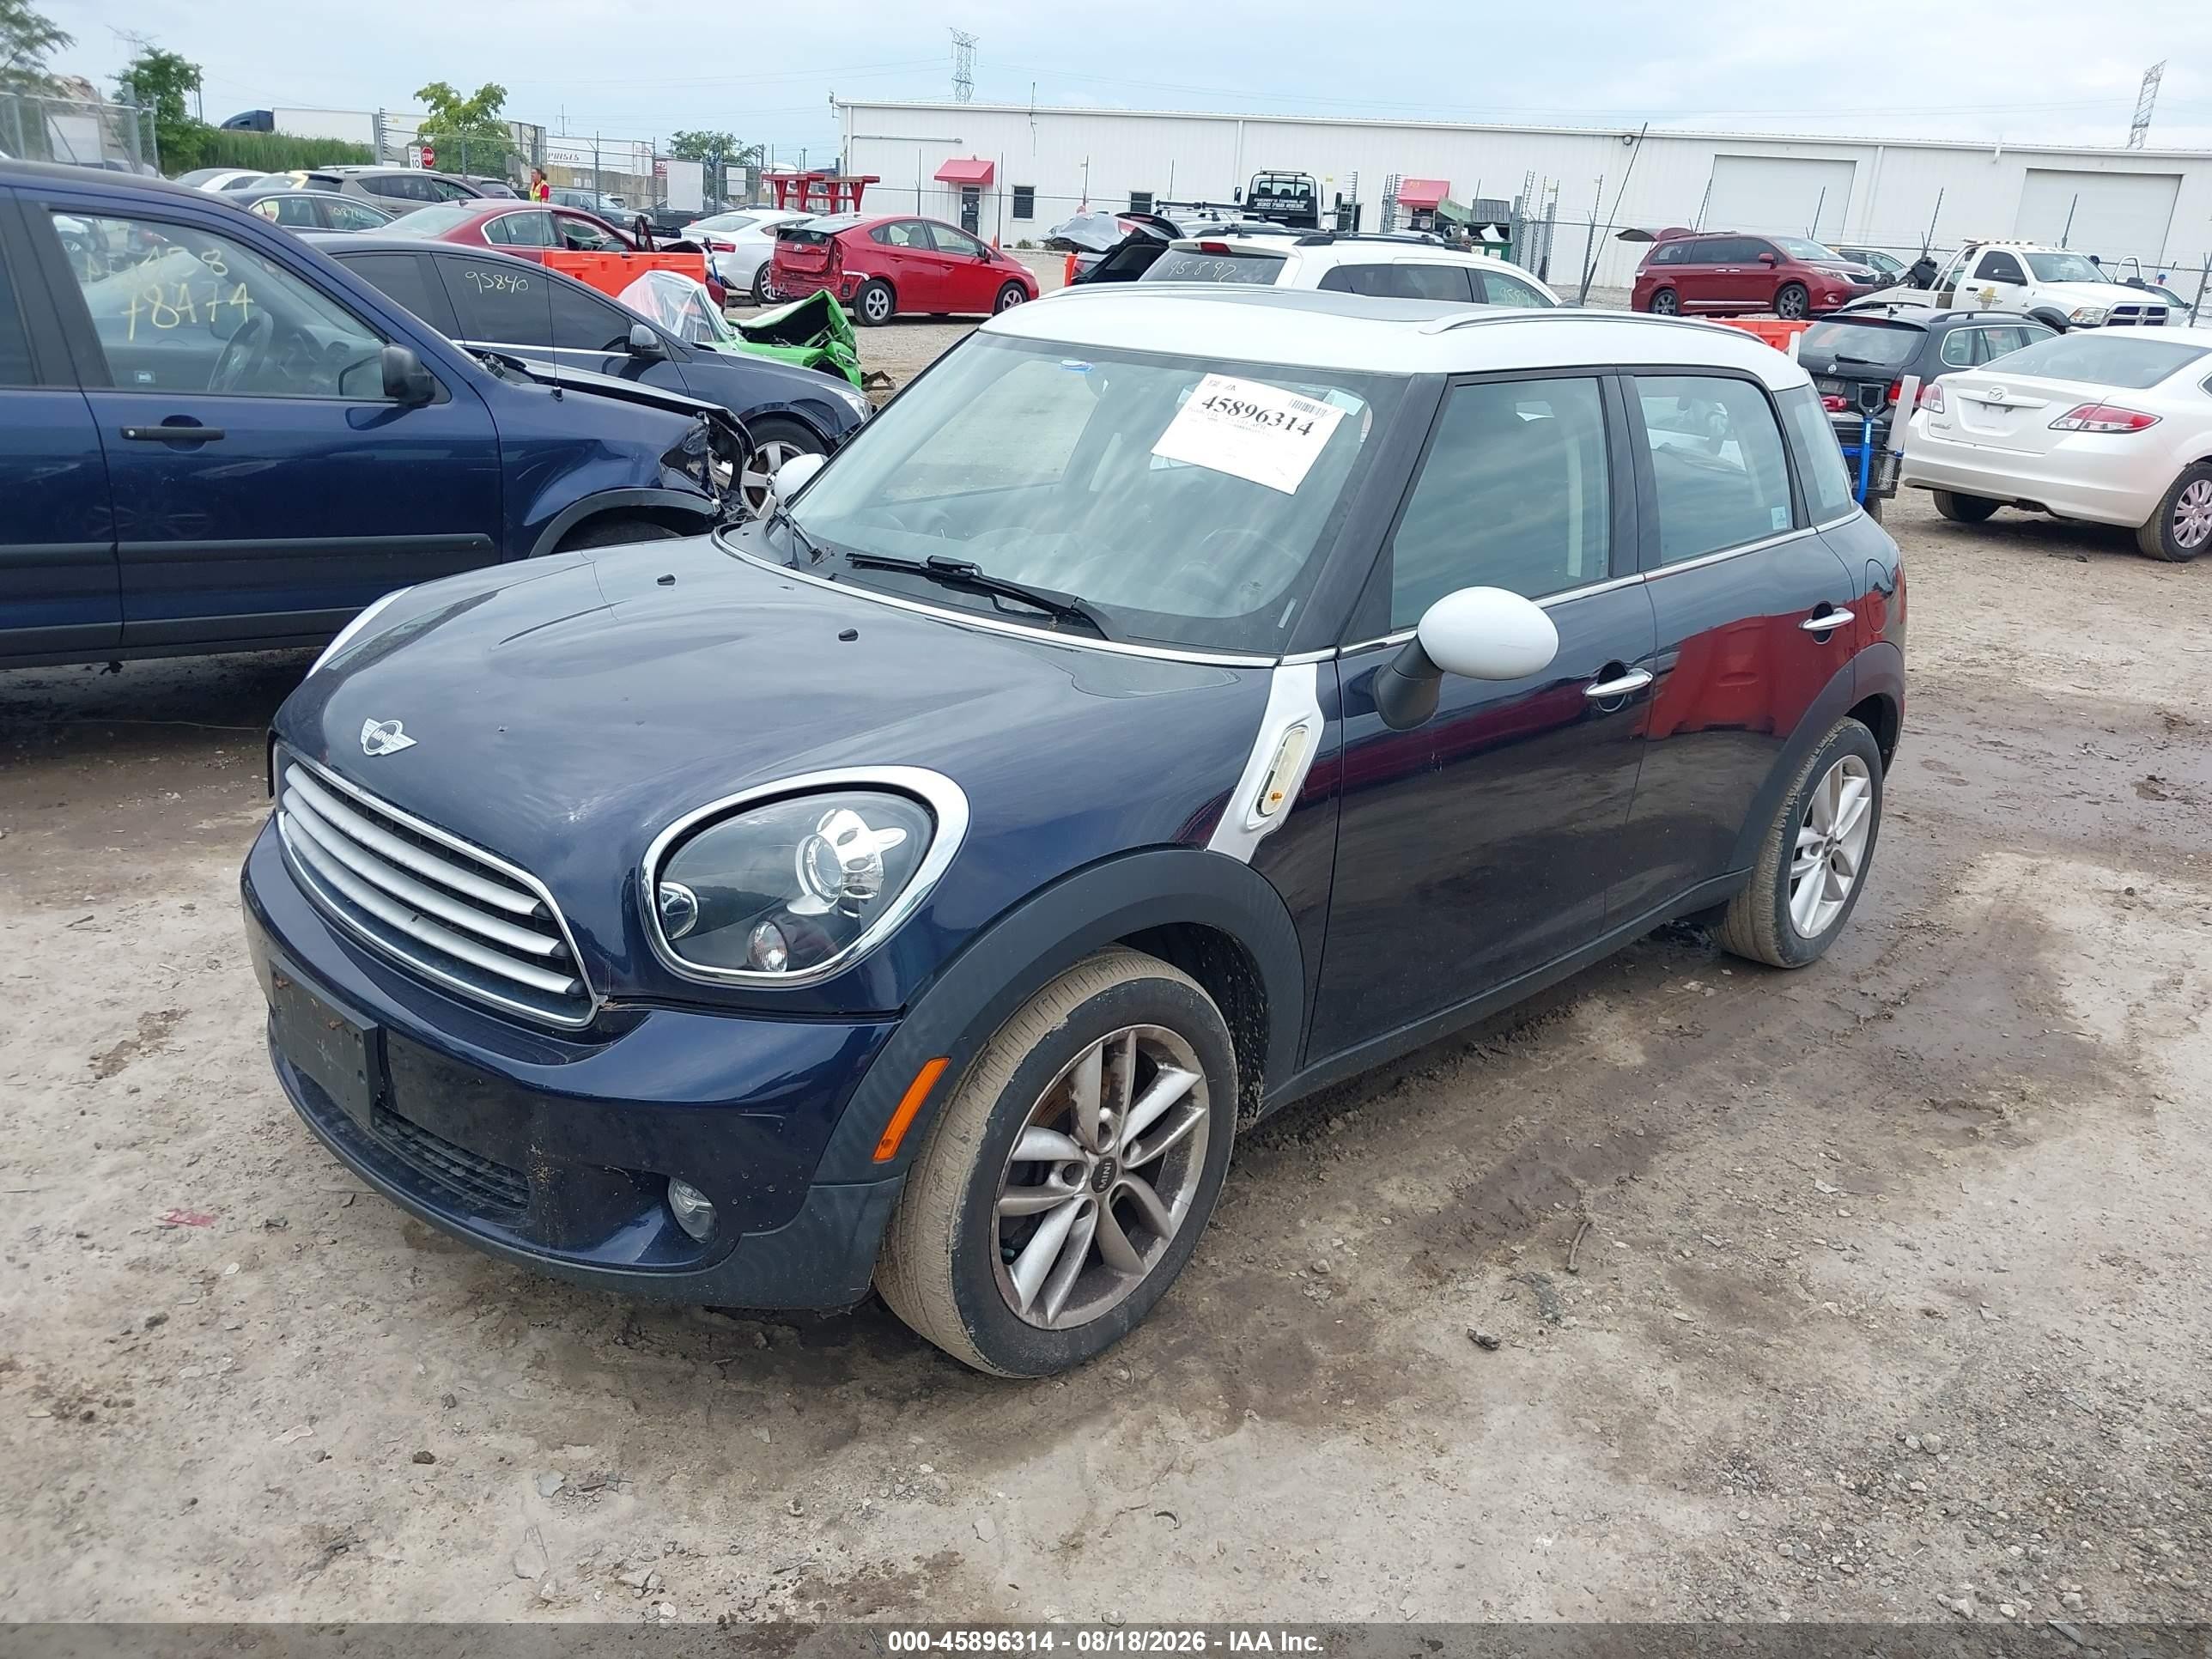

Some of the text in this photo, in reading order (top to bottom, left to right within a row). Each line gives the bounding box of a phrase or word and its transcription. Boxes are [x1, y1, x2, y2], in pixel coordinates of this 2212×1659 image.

[412, 159, 421, 168] 10
[465, 271, 529, 294] 95840
[1168, 260, 1237, 283] 95892
[1202, 395, 1315, 436] 45896314
[371, 728, 393, 744] MINI
[1098, 1162, 1112, 1188] MINI
